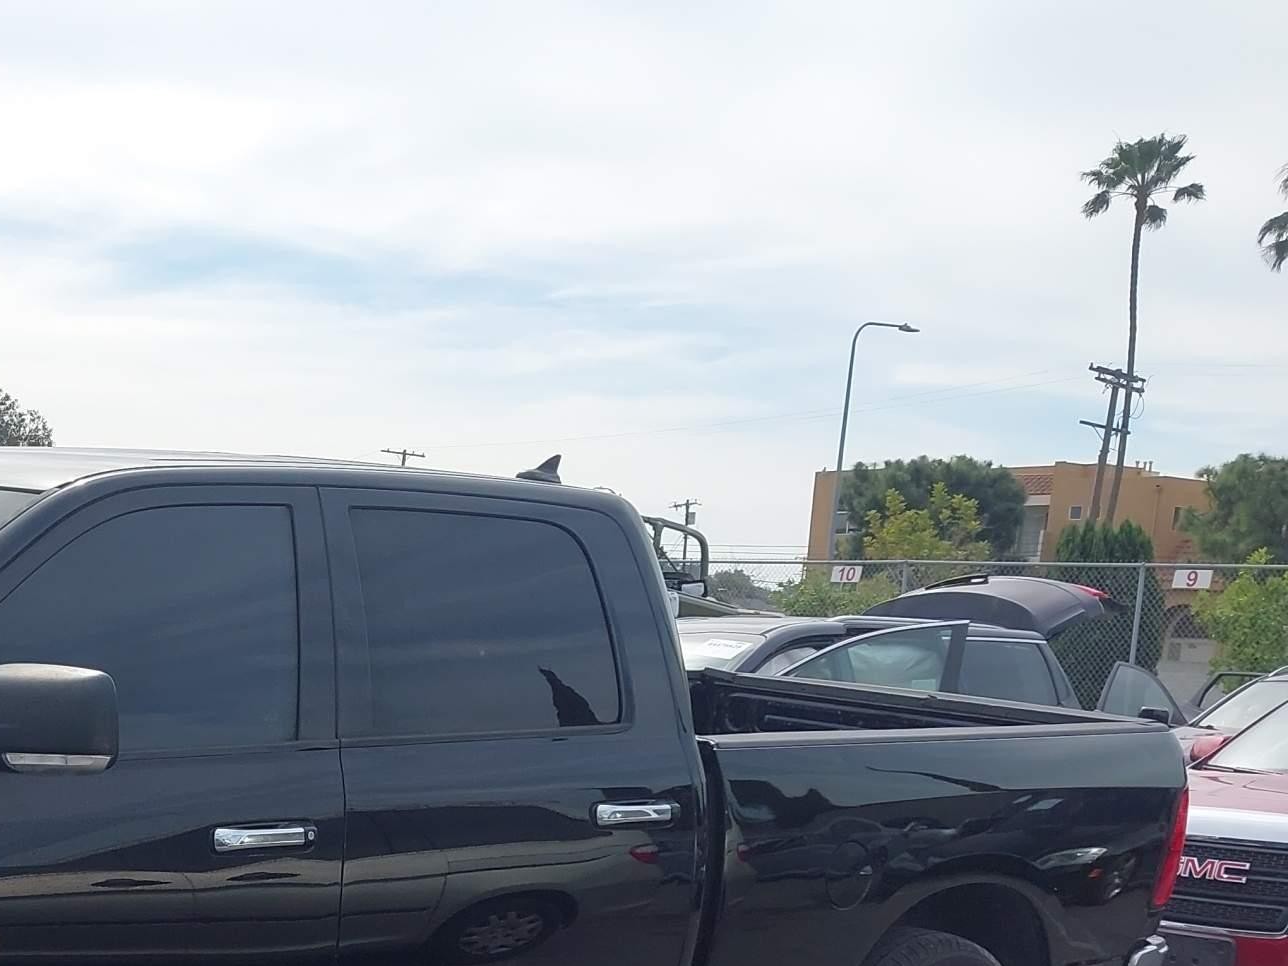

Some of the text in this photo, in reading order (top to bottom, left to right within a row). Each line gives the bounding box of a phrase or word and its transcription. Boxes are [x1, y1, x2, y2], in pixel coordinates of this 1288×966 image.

[836, 567, 857, 582] 10
[1185, 570, 1199, 587] 9
[1176, 855, 1251, 884] MC
